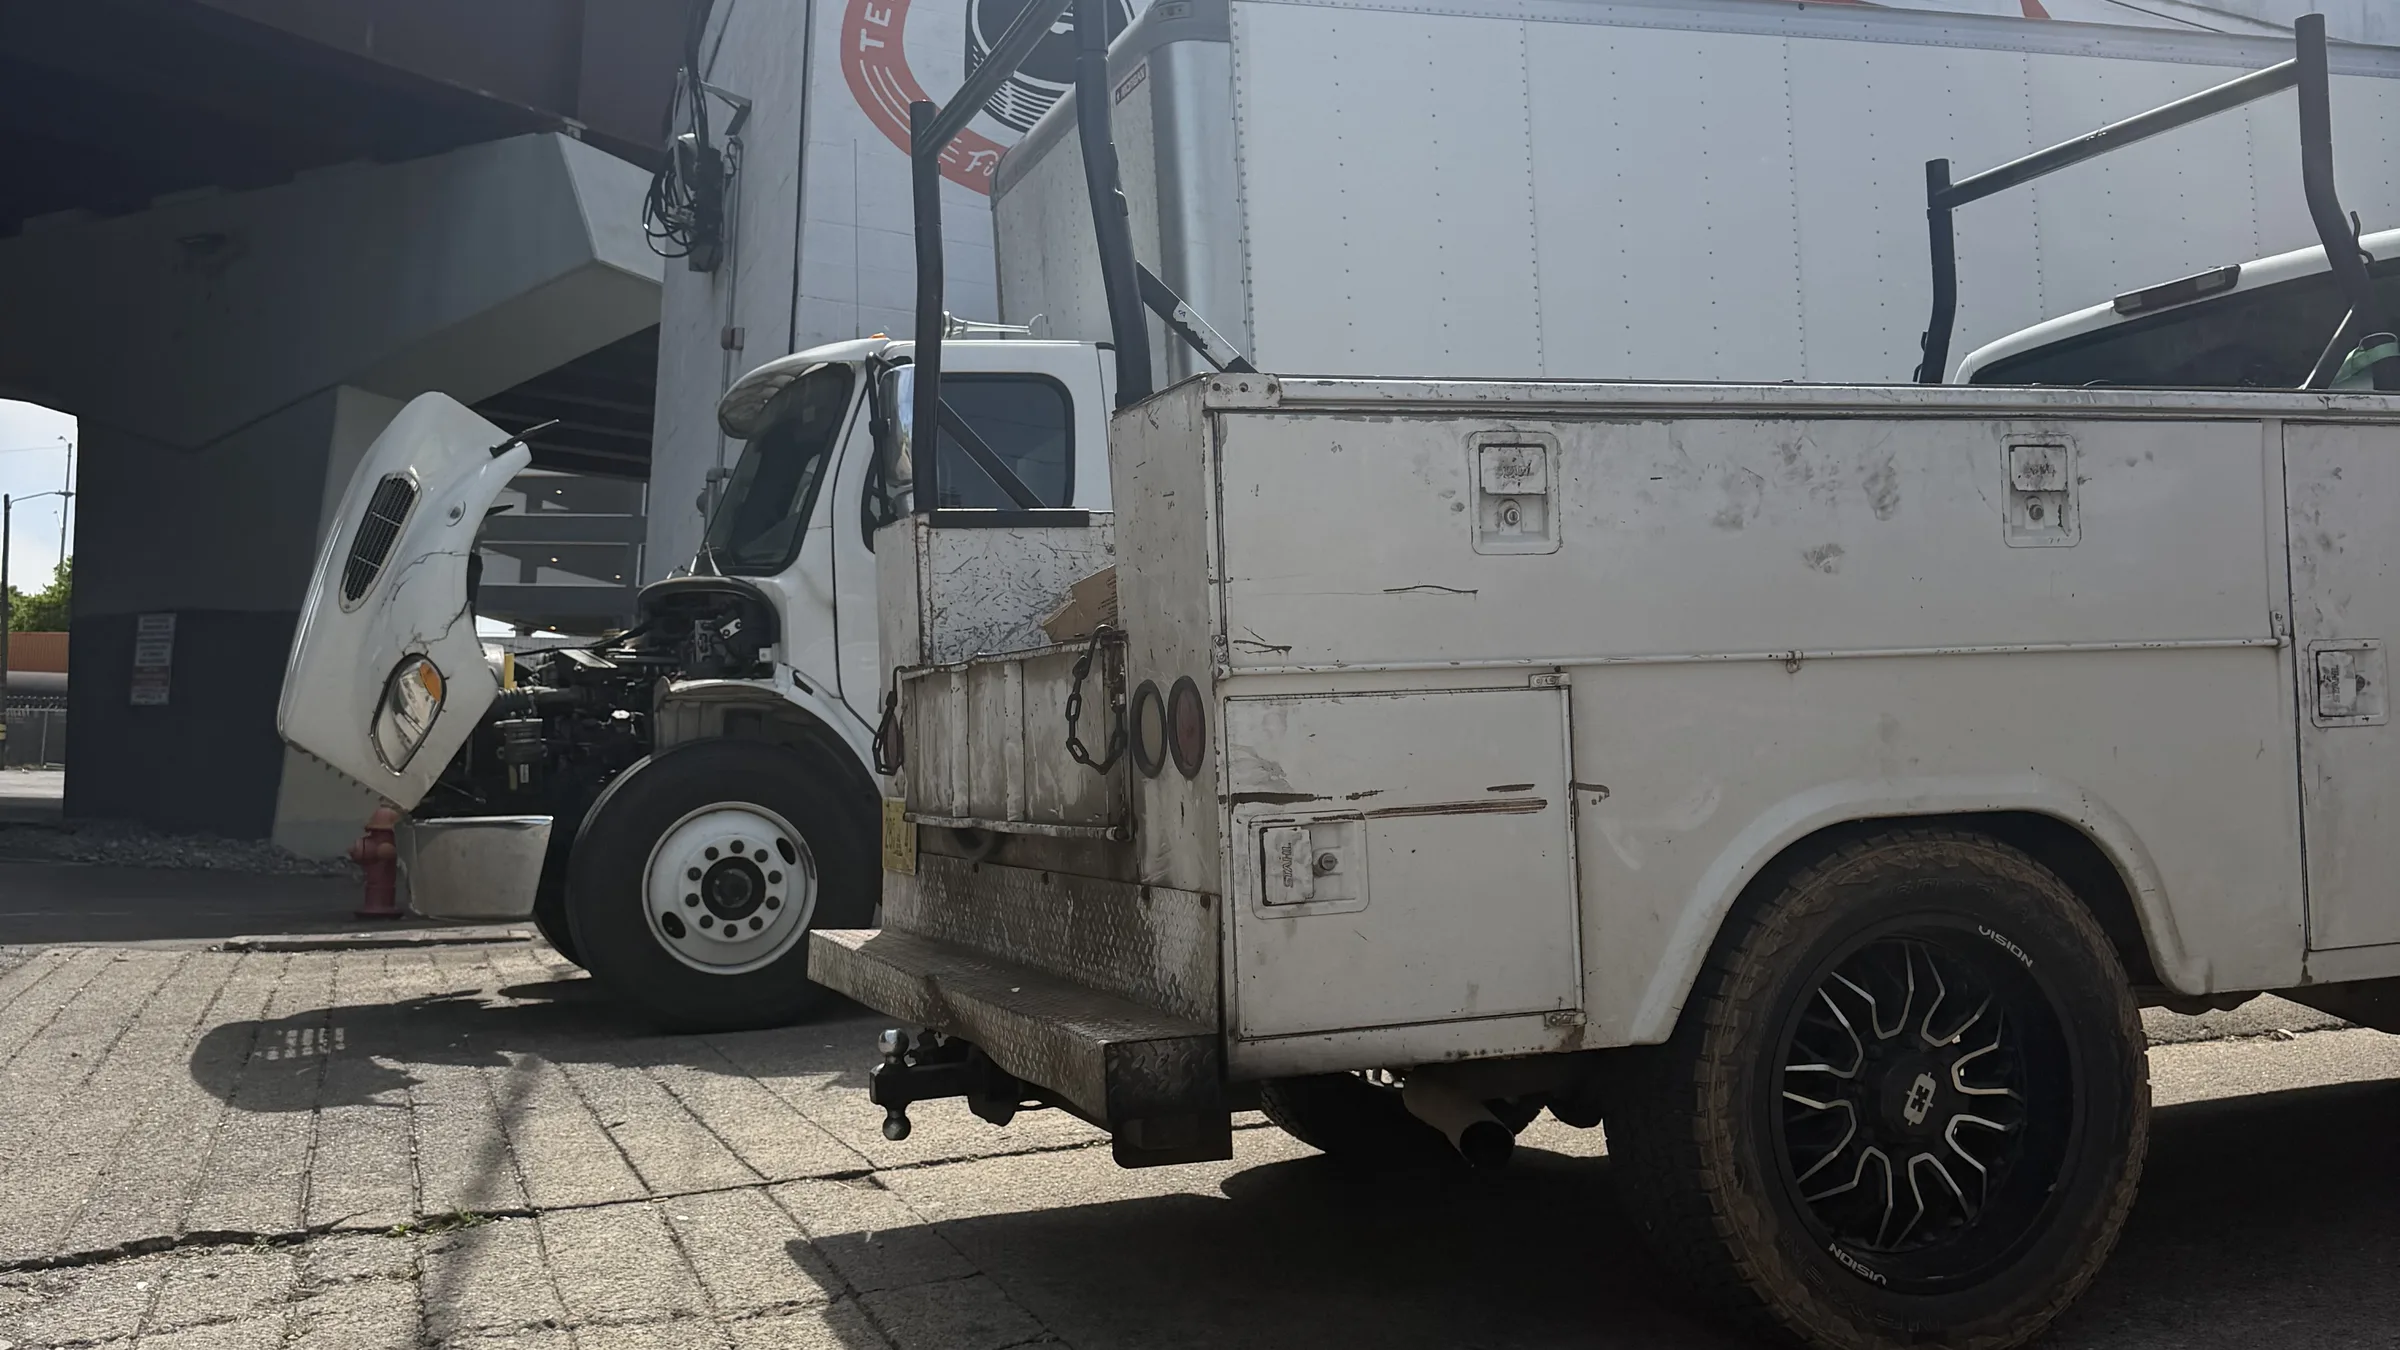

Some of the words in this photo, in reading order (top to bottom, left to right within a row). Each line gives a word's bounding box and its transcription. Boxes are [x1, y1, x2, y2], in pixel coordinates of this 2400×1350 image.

[860, 0, 896, 52] TE
[964, 149, 1000, 177] Fi
[1281, 842, 1294, 889] STAHL
[1978, 925, 2034, 968] VISION
[1828, 1243, 1887, 1286] VISION
